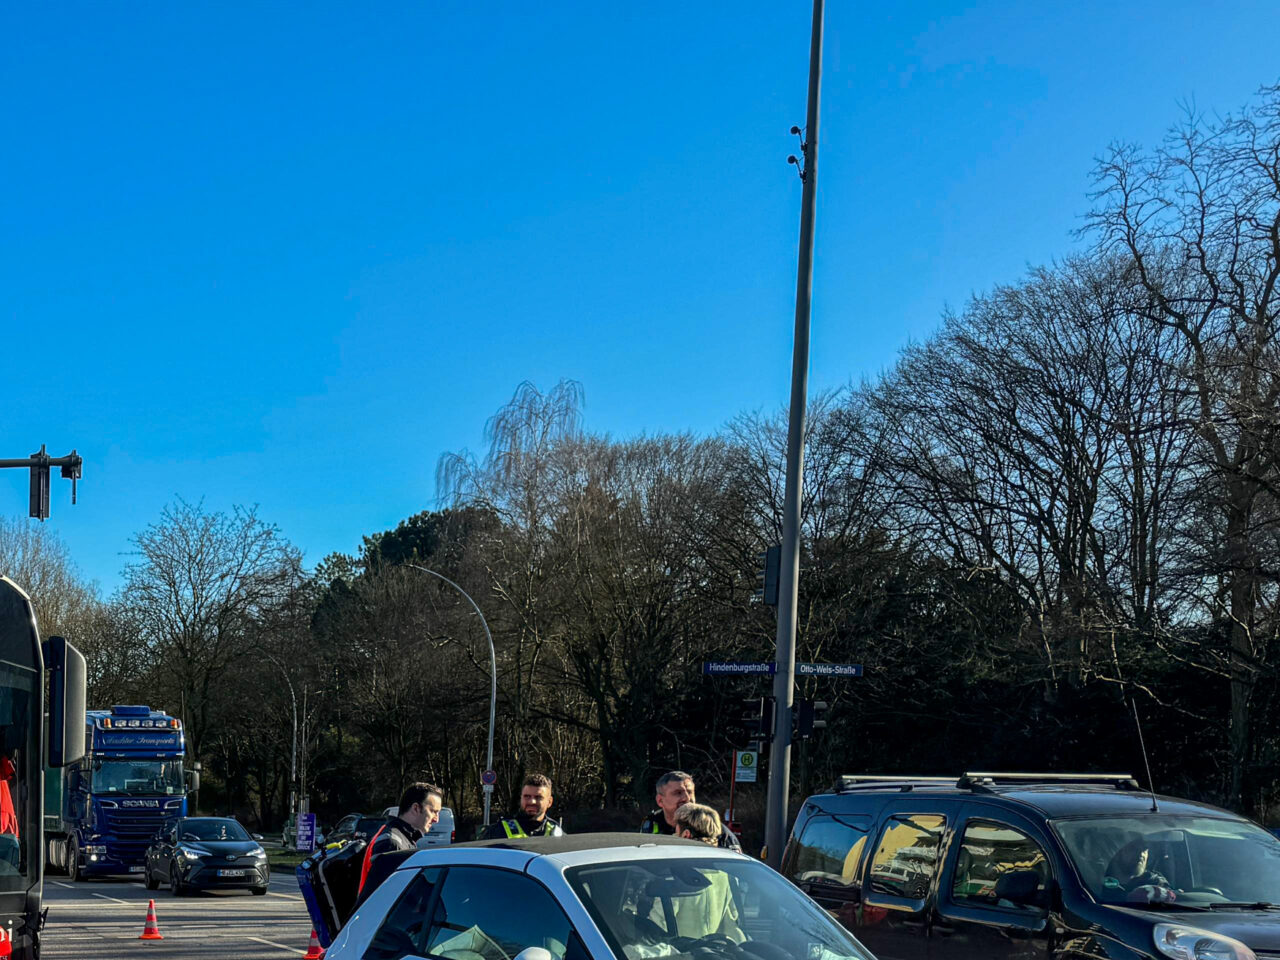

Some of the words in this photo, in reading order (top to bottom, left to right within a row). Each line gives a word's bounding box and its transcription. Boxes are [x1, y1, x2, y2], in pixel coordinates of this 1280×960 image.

[709, 663, 770, 674] Hindenburgstraße
[800, 664, 856, 675] Otto-Wels-Straße
[122, 799, 160, 808] SCANIA
